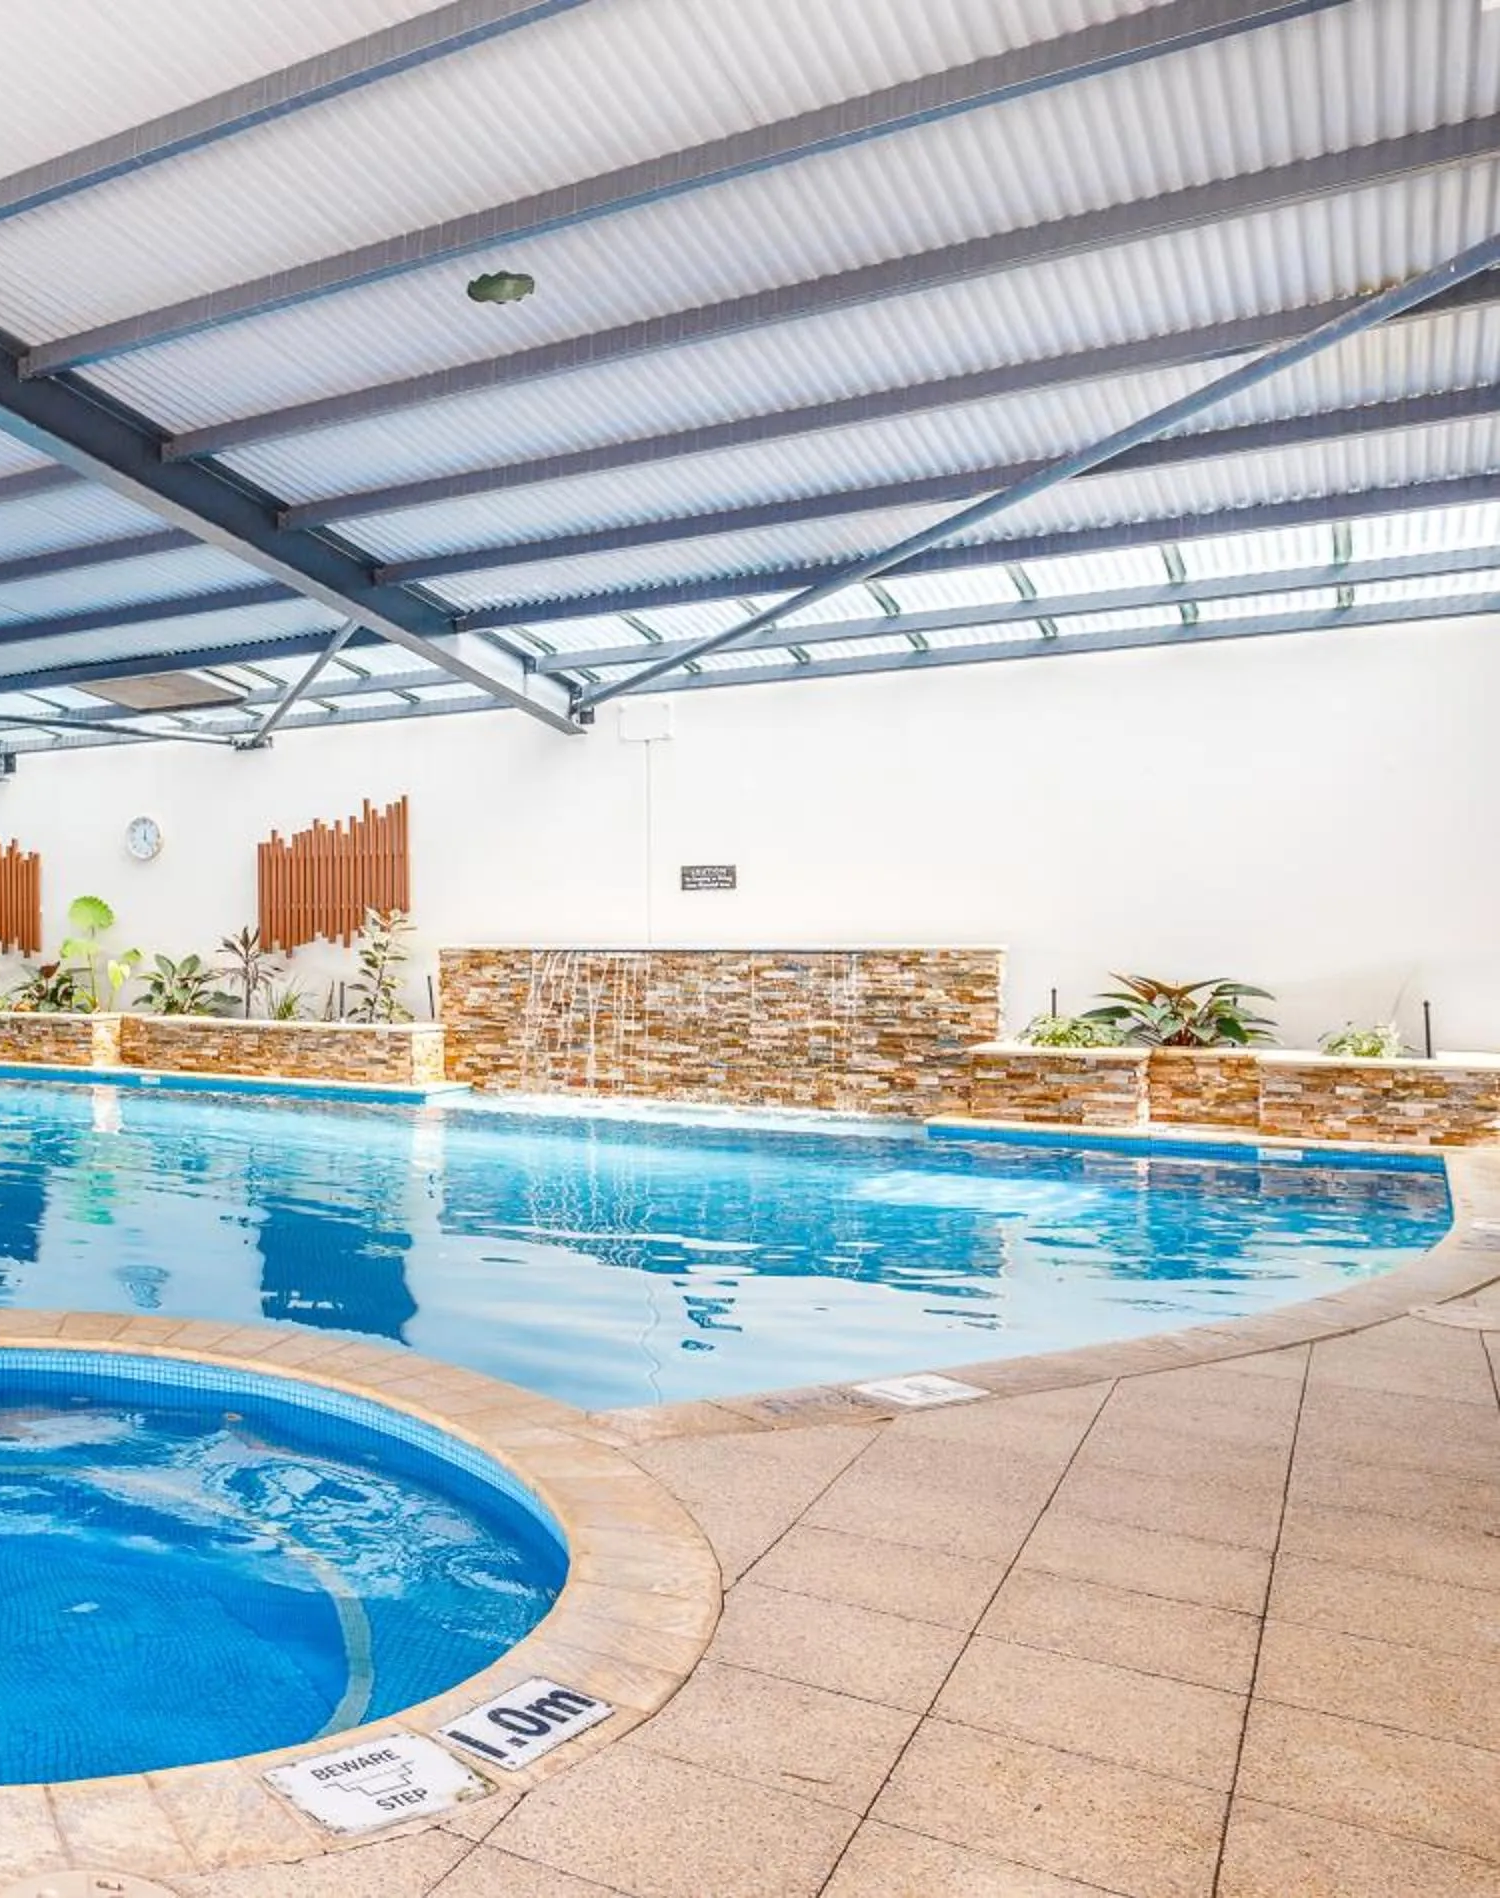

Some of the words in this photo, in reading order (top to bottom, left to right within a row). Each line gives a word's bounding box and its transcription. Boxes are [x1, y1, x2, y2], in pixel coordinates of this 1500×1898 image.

[446, 1688, 597, 1759] 1.0m
[310, 1749, 401, 1781] BEWARE
[376, 1787, 428, 1811] STEP
